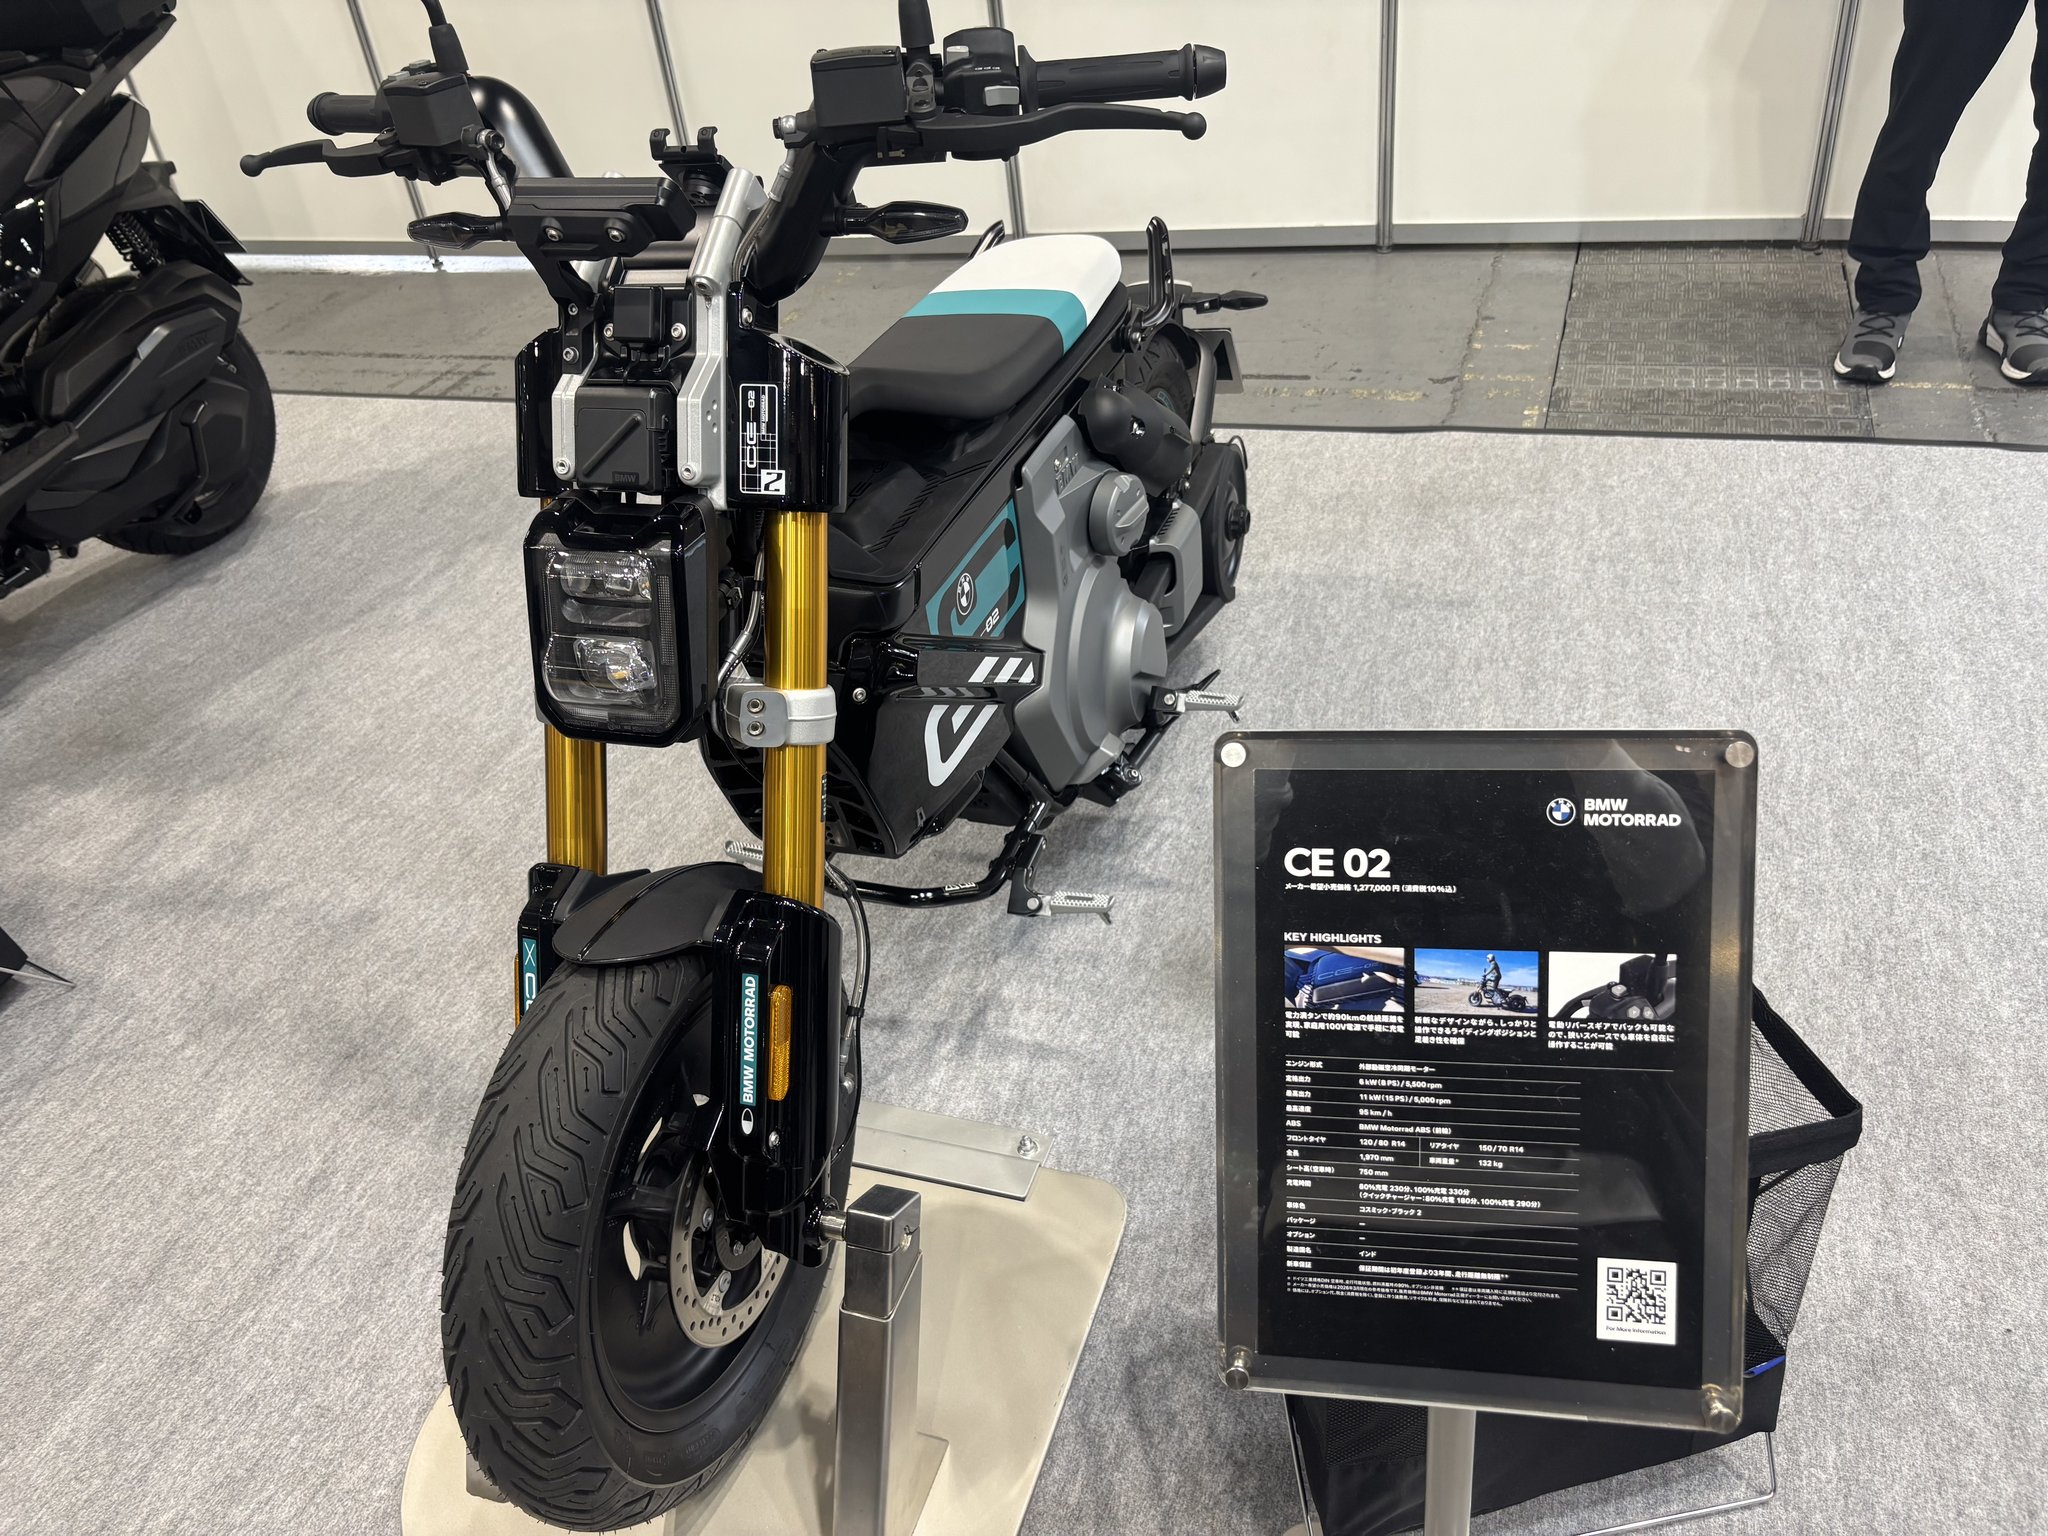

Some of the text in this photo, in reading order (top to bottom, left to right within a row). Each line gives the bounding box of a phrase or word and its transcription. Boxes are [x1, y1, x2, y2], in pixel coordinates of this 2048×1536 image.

[1584, 798, 1629, 812] BMW
[1583, 813, 1682, 827] MOTORRAD
[1284, 847, 1391, 878] CE 02
[1284, 932, 1381, 943] KEY HIGHLIGHTS
[742, 976, 756, 1103] BMW MOTORRAD
